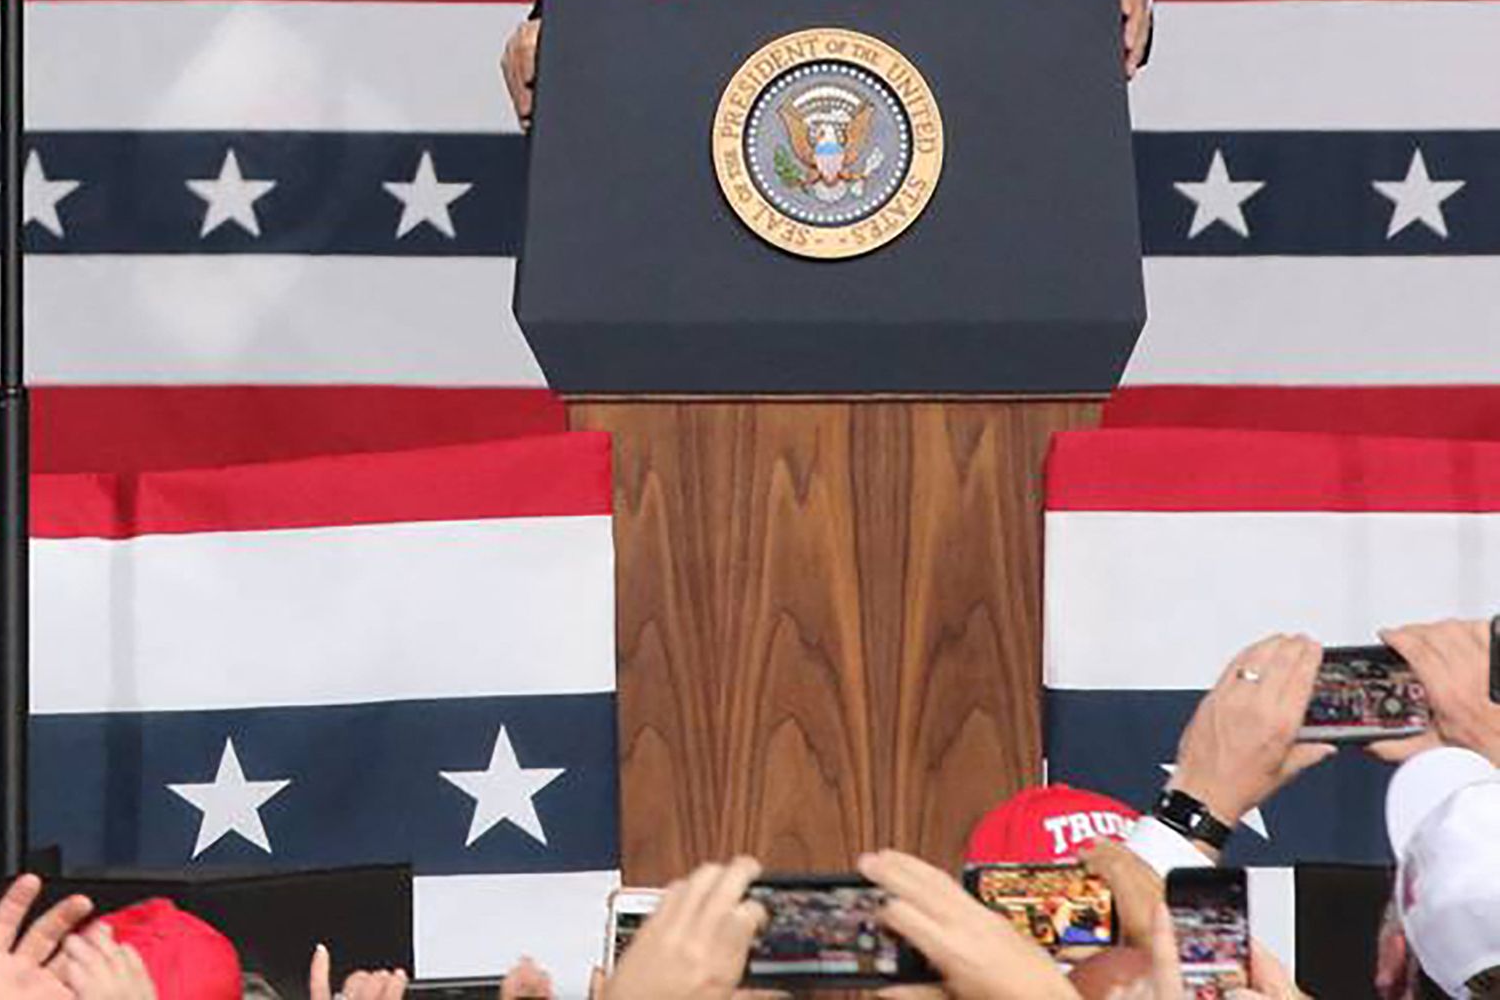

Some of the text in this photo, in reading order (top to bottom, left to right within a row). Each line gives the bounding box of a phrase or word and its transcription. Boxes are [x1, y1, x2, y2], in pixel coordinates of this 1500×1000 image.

[721, 39, 820, 138] PRESIDENT
[886, 63, 936, 155] UNITED
[851, 174, 927, 244] STATES
[1044, 810, 1136, 854] TRU
